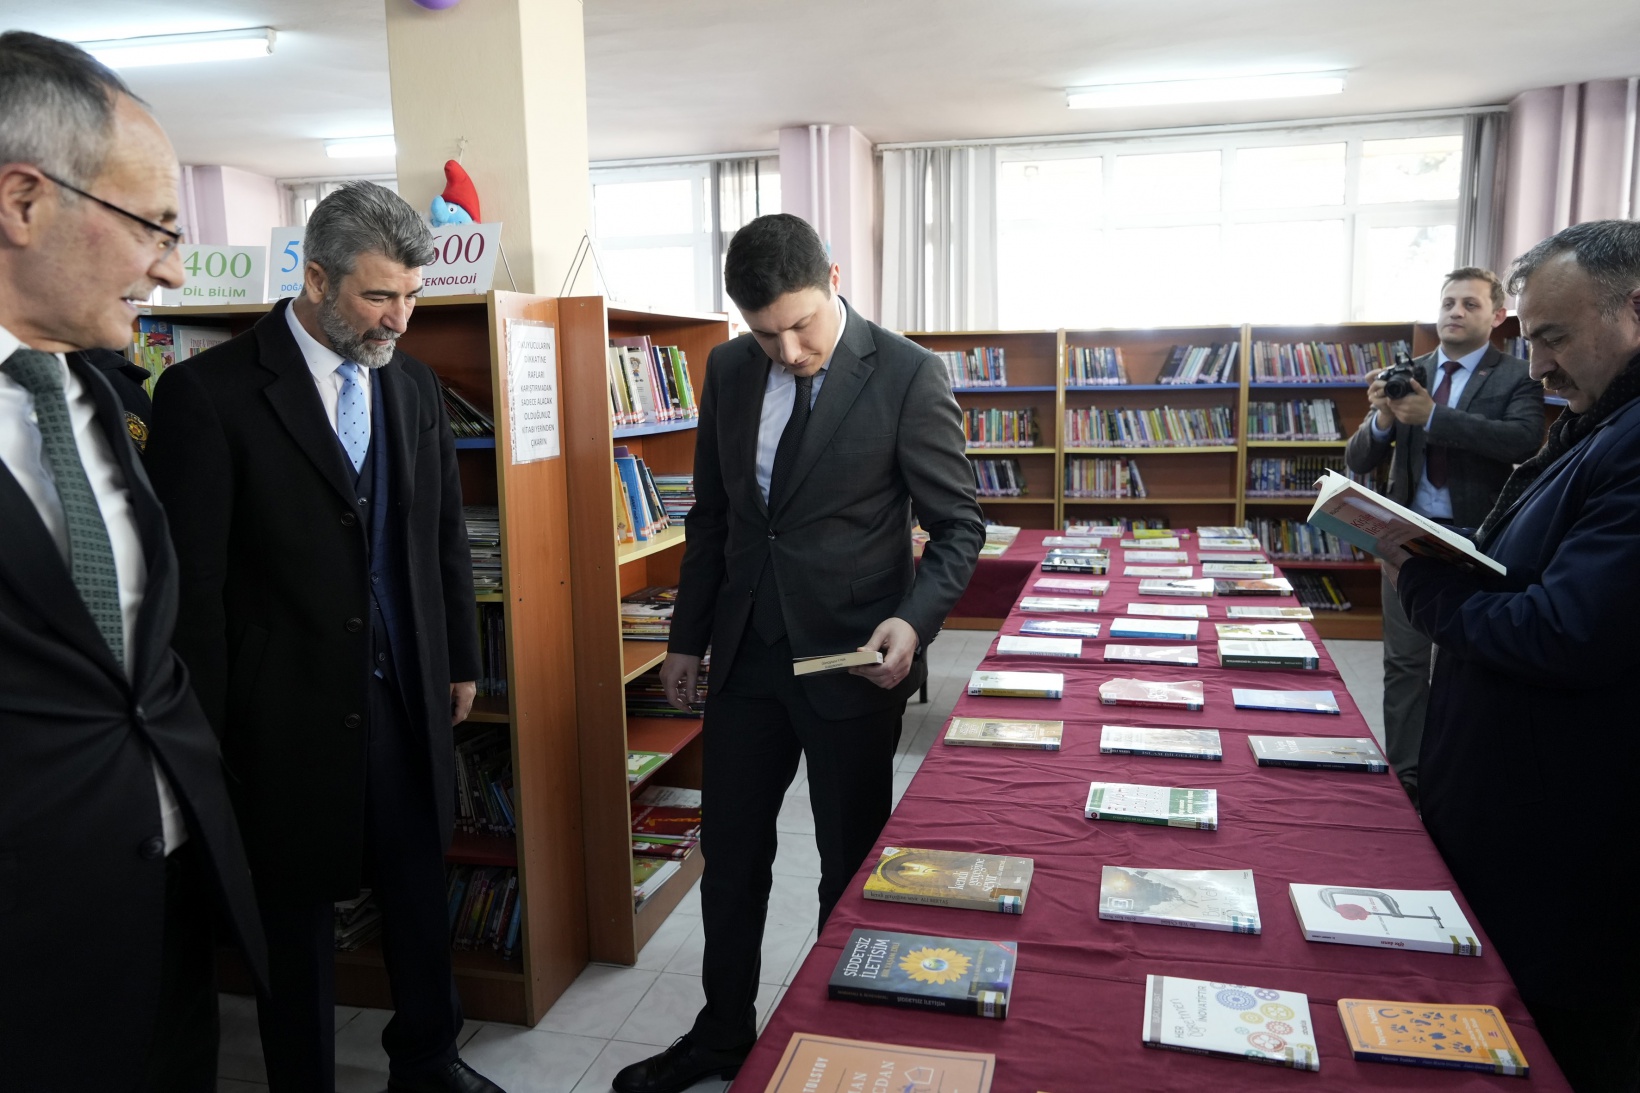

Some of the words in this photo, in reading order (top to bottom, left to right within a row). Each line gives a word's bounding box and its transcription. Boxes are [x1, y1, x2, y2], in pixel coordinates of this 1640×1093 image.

[184, 250, 252, 278] 400
[281, 240, 300, 273] 5
[183, 286, 204, 297] DİL
[208, 286, 247, 298] BİLİM
[843, 937, 872, 977] ŞİDDETSİZ
[858, 938, 891, 979] İLETİŞİM
[803, 1056, 829, 1093] TOLSTOY
